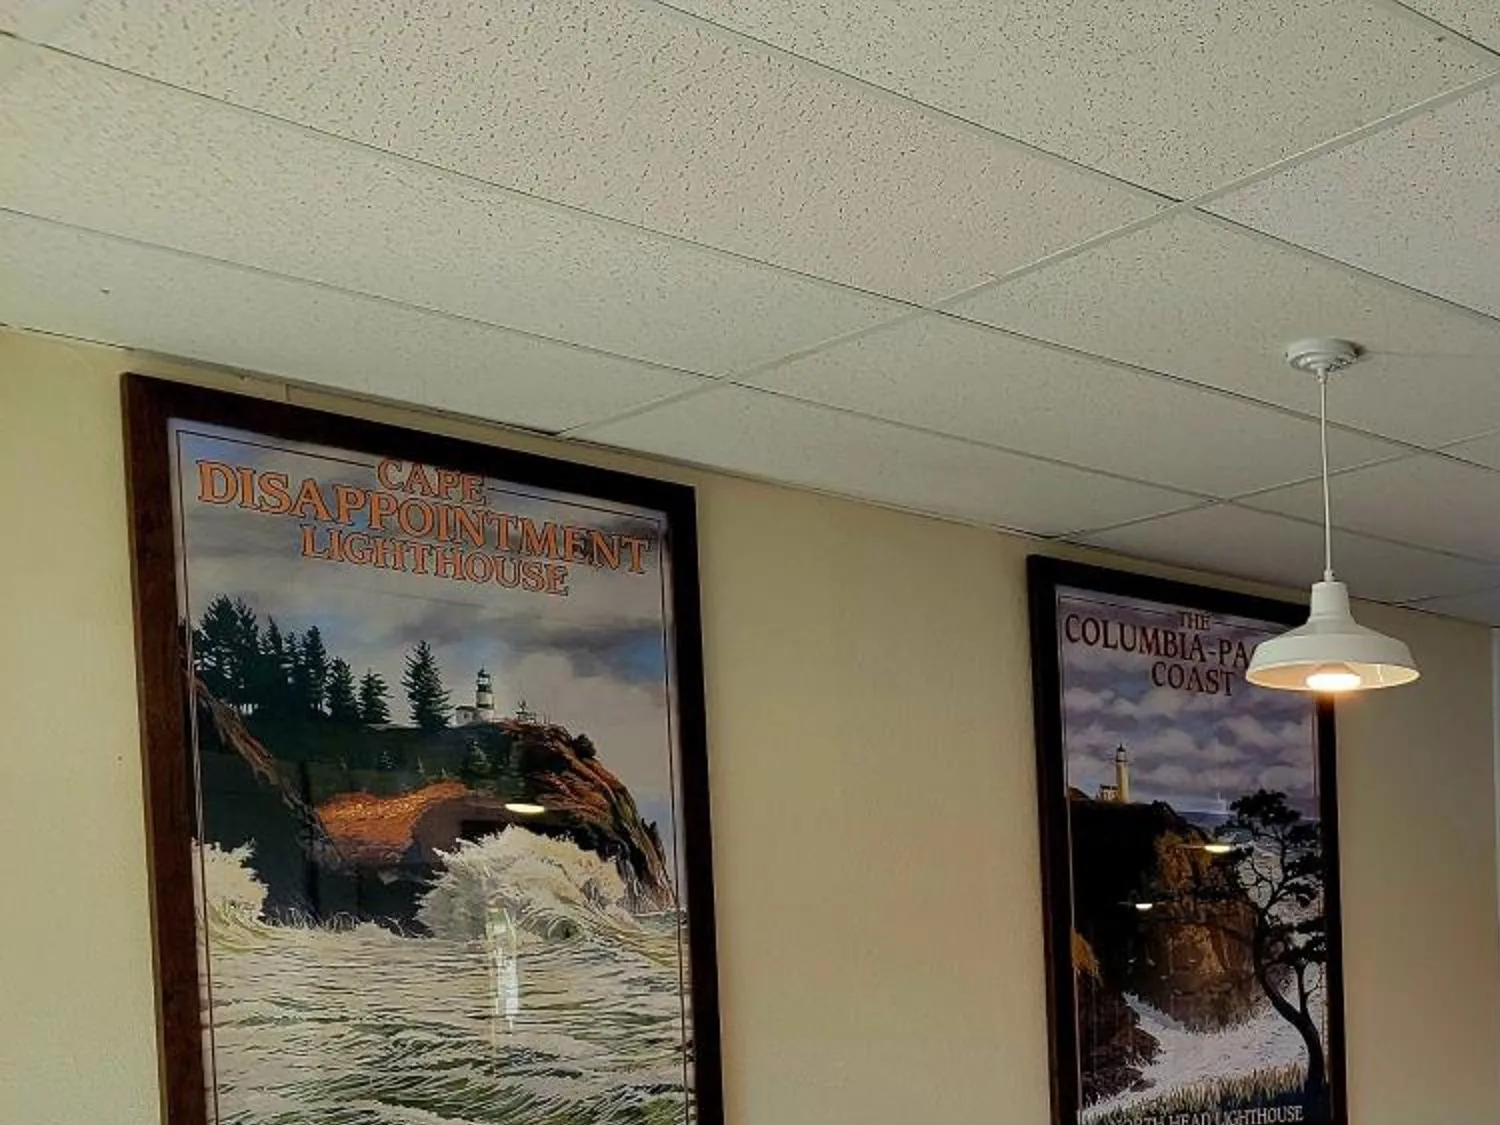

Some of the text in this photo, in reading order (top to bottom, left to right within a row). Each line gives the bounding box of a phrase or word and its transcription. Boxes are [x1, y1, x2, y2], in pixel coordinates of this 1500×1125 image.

[376, 456, 486, 505] CAPE
[196, 459, 651, 575] DISAPPOINTMENT
[301, 523, 569, 596] LIGHTHOUSE
[1065, 613, 1257, 669] COLUMBIA-PA
[1179, 612, 1211, 631] THE
[1152, 661, 1235, 696] COAST
